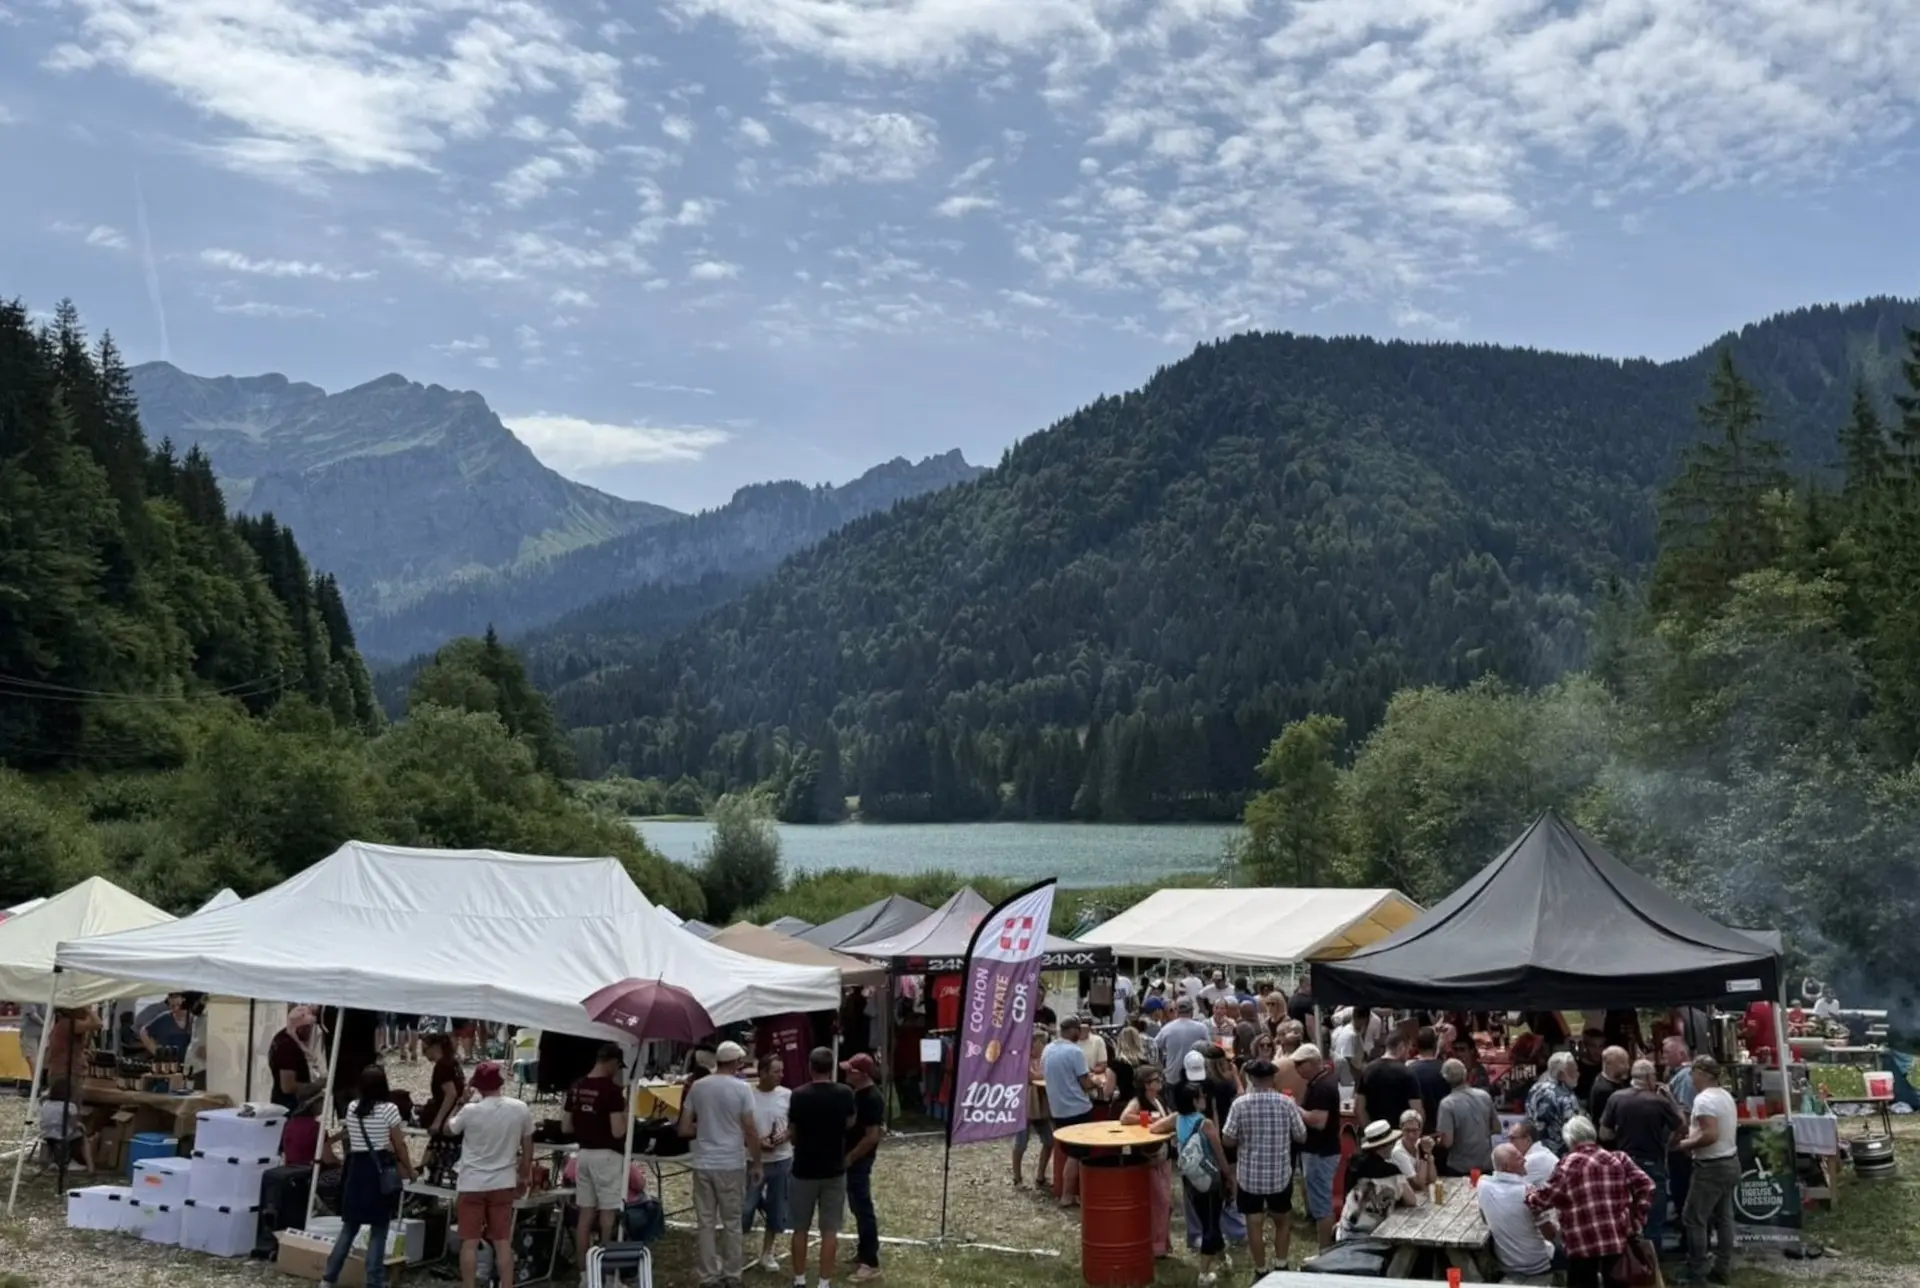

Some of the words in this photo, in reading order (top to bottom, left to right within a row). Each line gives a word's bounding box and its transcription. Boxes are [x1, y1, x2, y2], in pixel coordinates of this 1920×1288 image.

[1041, 952, 1095, 965] 24MX
[970, 967, 989, 1033] COCHON
[991, 974, 1009, 1028] PATATE
[1011, 983, 1028, 1023] CDR
[961, 1081, 1024, 1109] 100%
[963, 1108, 1017, 1123] LOCAL
[1741, 1196, 1783, 1206] PRESSION
